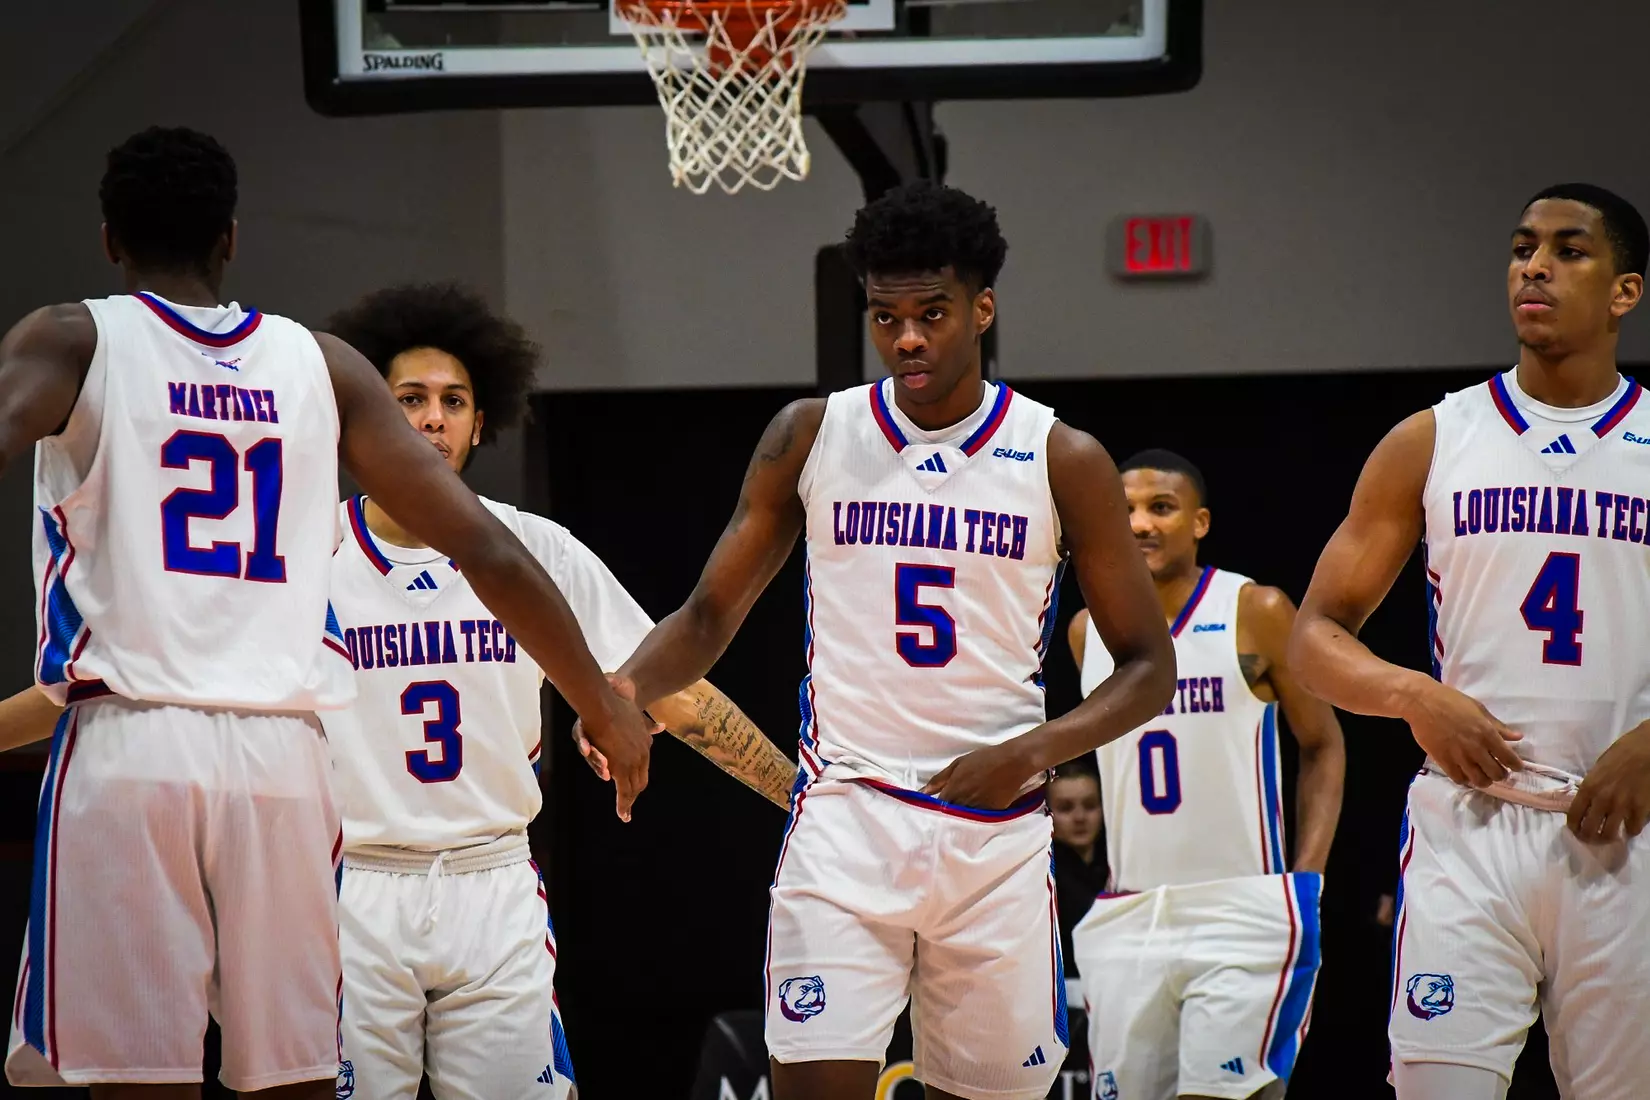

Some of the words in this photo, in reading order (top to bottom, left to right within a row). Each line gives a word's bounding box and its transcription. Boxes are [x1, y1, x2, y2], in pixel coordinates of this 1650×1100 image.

[363, 53, 443, 72] SPALDING
[1124, 215, 1193, 272] EXIT
[168, 382, 279, 424] MARTINEZ
[160, 429, 287, 584] 21
[834, 501, 958, 552] LOUISIANA
[965, 510, 1029, 560] TECH
[1454, 486, 1590, 537] LOUISIANA
[895, 563, 958, 667] 5
[1520, 552, 1584, 667] 4
[344, 620, 458, 671] OUISIANA
[1177, 677, 1225, 714] TECH
[401, 680, 462, 783] 3
[1138, 729, 1183, 815] 0
